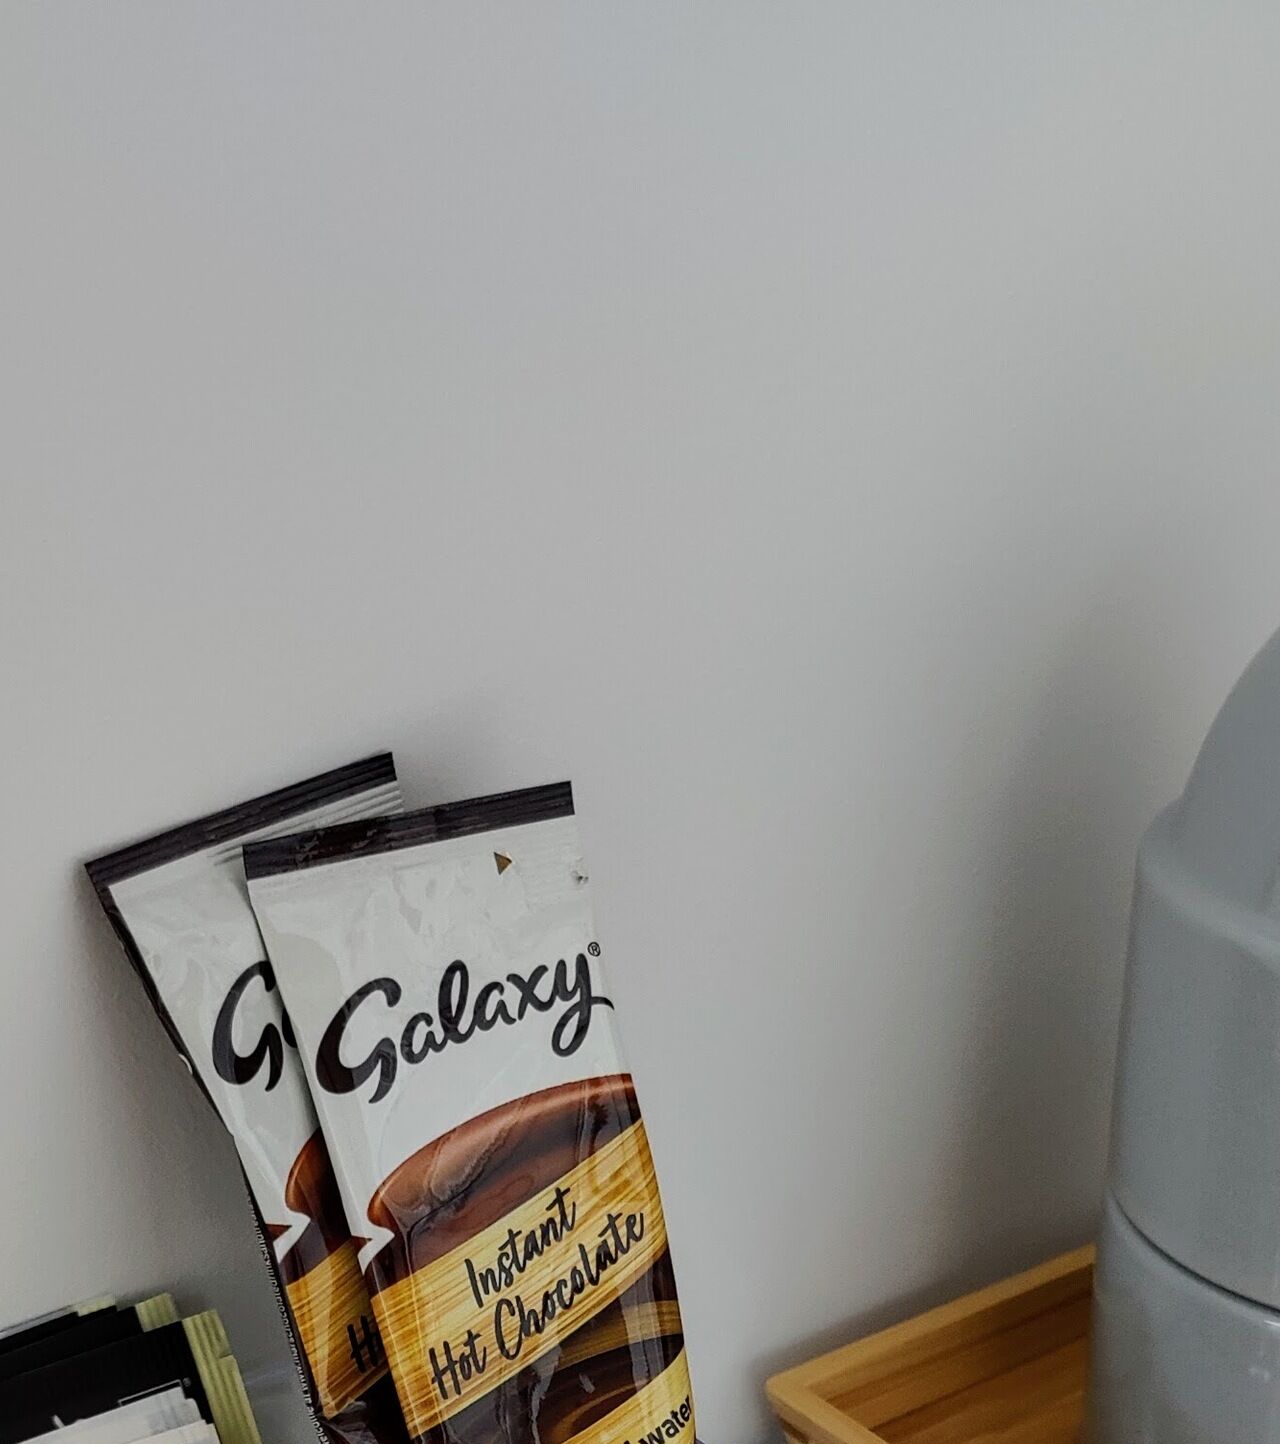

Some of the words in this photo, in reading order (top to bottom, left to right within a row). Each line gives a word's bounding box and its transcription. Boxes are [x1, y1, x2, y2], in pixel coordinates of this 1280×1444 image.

[316, 953, 614, 1104] Galaxy
[431, 1330, 487, 1400] Hot
[494, 1212, 646, 1359] Chocolate
[465, 1187, 578, 1307] Instant
